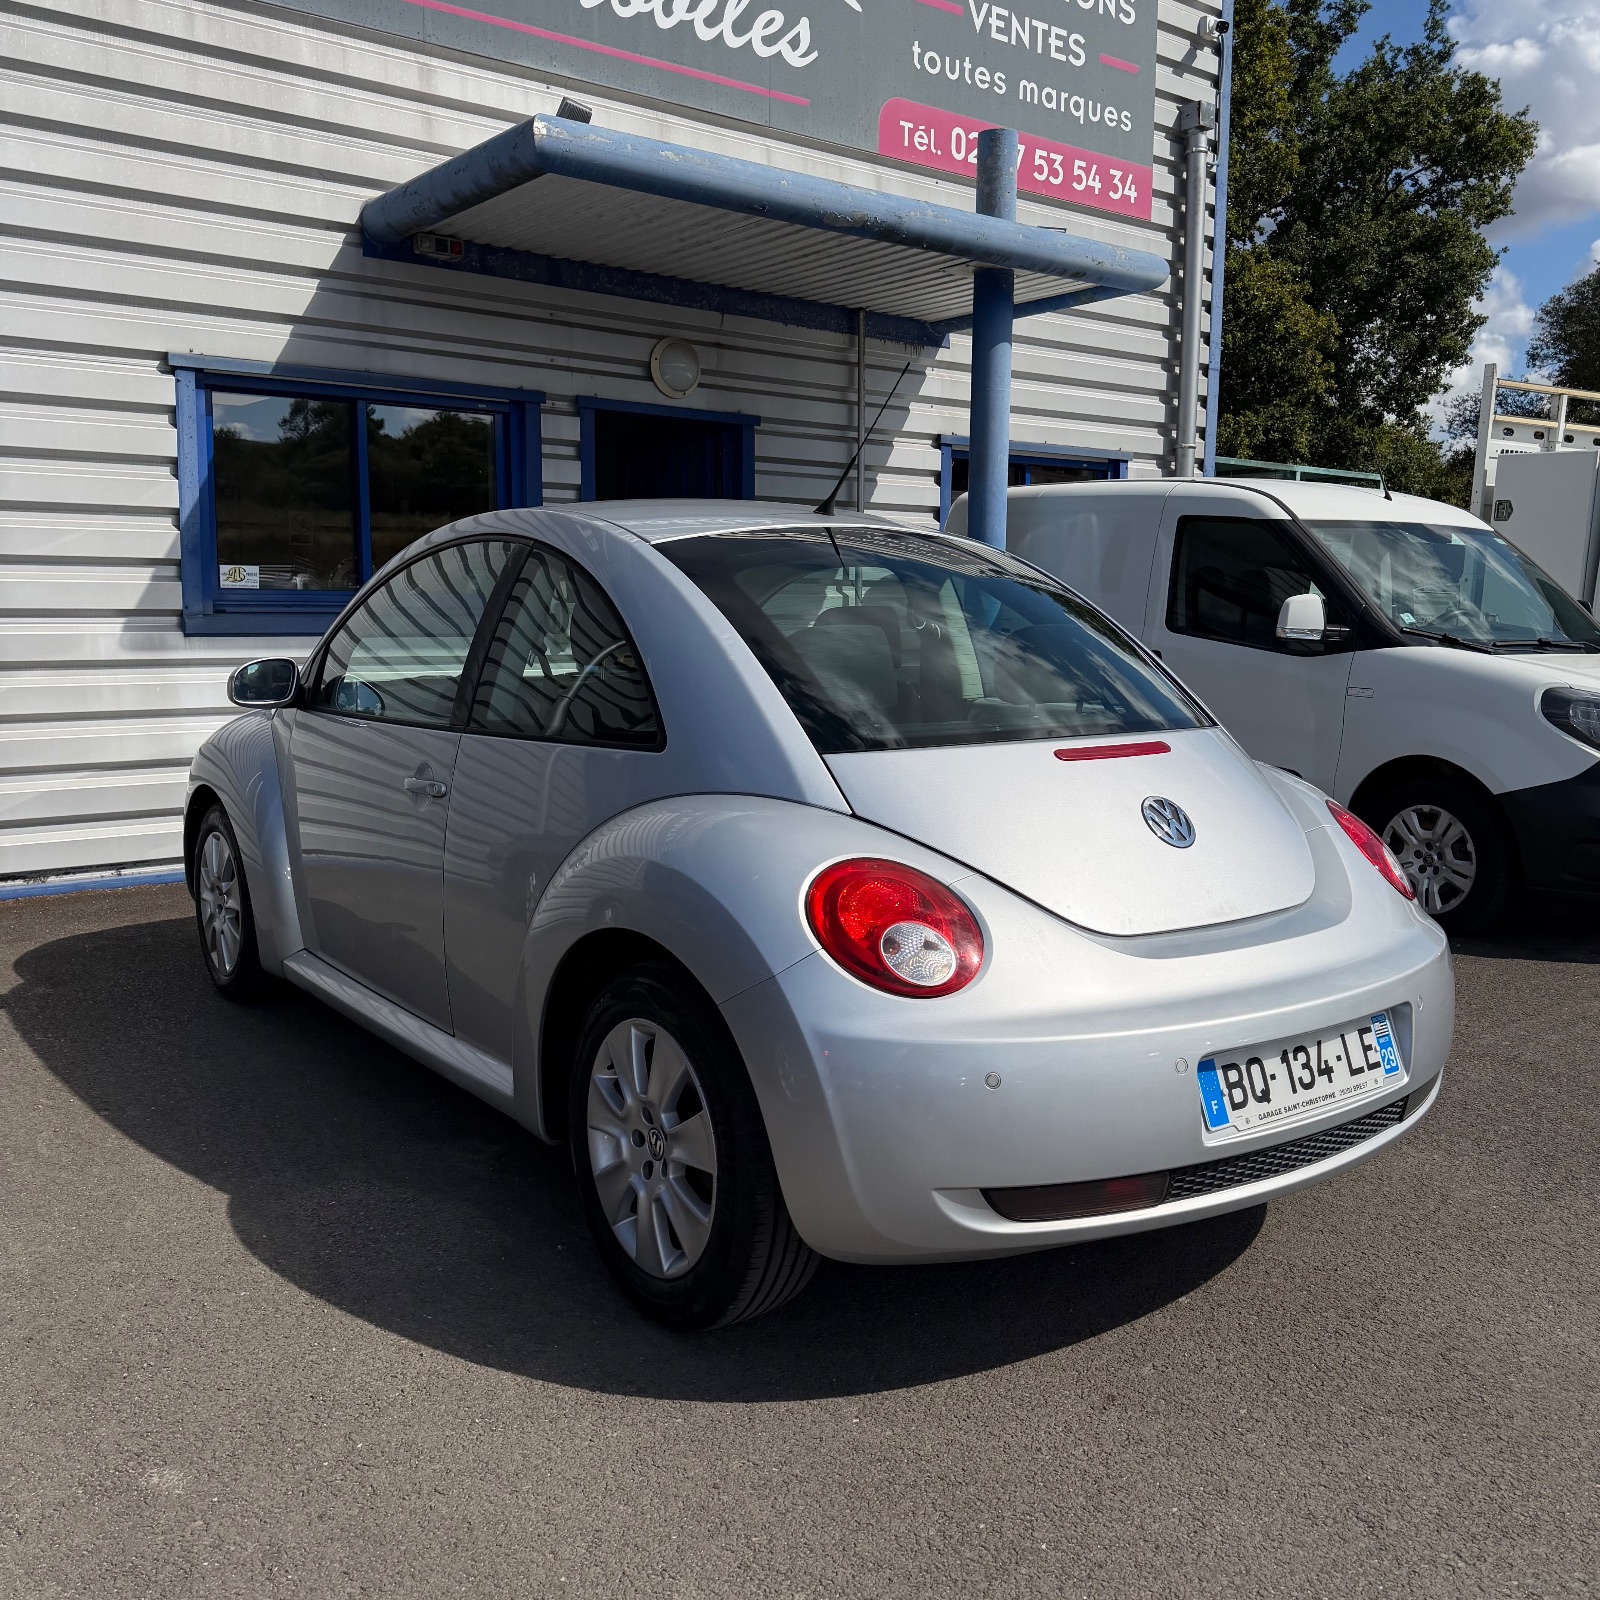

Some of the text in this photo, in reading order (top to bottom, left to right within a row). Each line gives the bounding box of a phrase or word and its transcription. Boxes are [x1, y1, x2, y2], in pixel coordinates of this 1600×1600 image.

[968, 0, 1086, 67] VENTES
[912, 41, 1132, 132] toutes marques
[900, 120, 942, 155] Tél.
[1033, 149, 1064, 185] 53
[1072, 159, 1101, 195] 54
[1109, 169, 1137, 203] 34
[1381, 1047, 1396, 1070] 29
[1211, 1100, 1219, 1115] F
[1258, 1108, 1283, 1120] GARAGE
